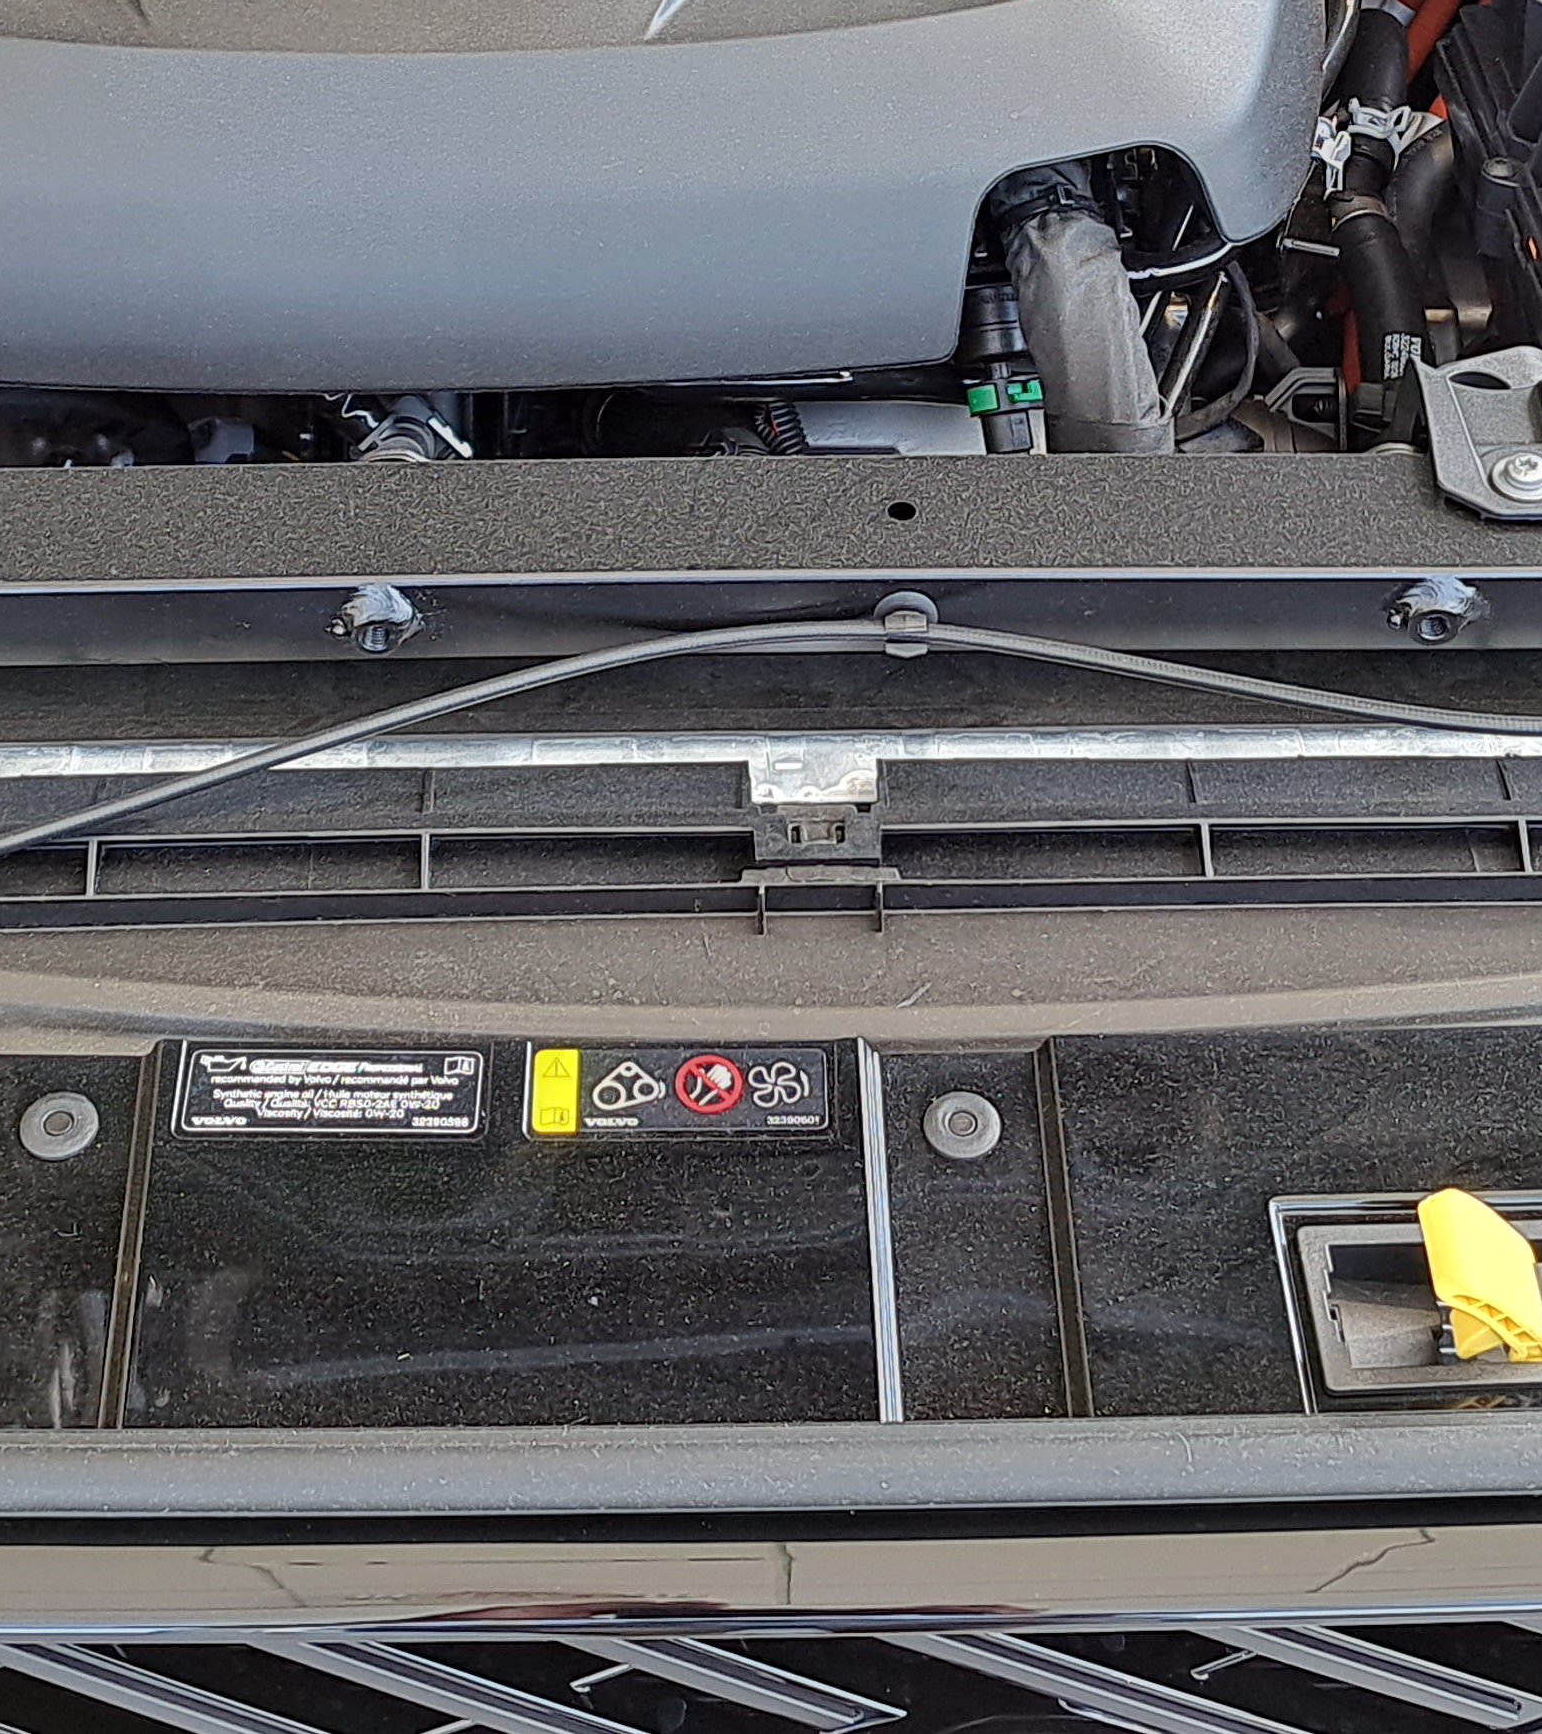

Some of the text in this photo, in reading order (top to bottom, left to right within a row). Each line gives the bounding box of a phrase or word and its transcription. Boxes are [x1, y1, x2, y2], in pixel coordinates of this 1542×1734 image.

[211, 1076, 287, 1084] recommended
[287, 1076, 303, 1086] by
[304, 1075, 333, 1085] Volvo
[410, 1077, 429, 1087] par
[430, 1074, 459, 1085] Volvo
[212, 1088, 263, 1100] Synthetic
[264, 1090, 300, 1100] engine
[301, 1089, 315, 1099] oil
[190, 1116, 248, 1126] VOLVO
[584, 1117, 639, 1127] VOLVO
